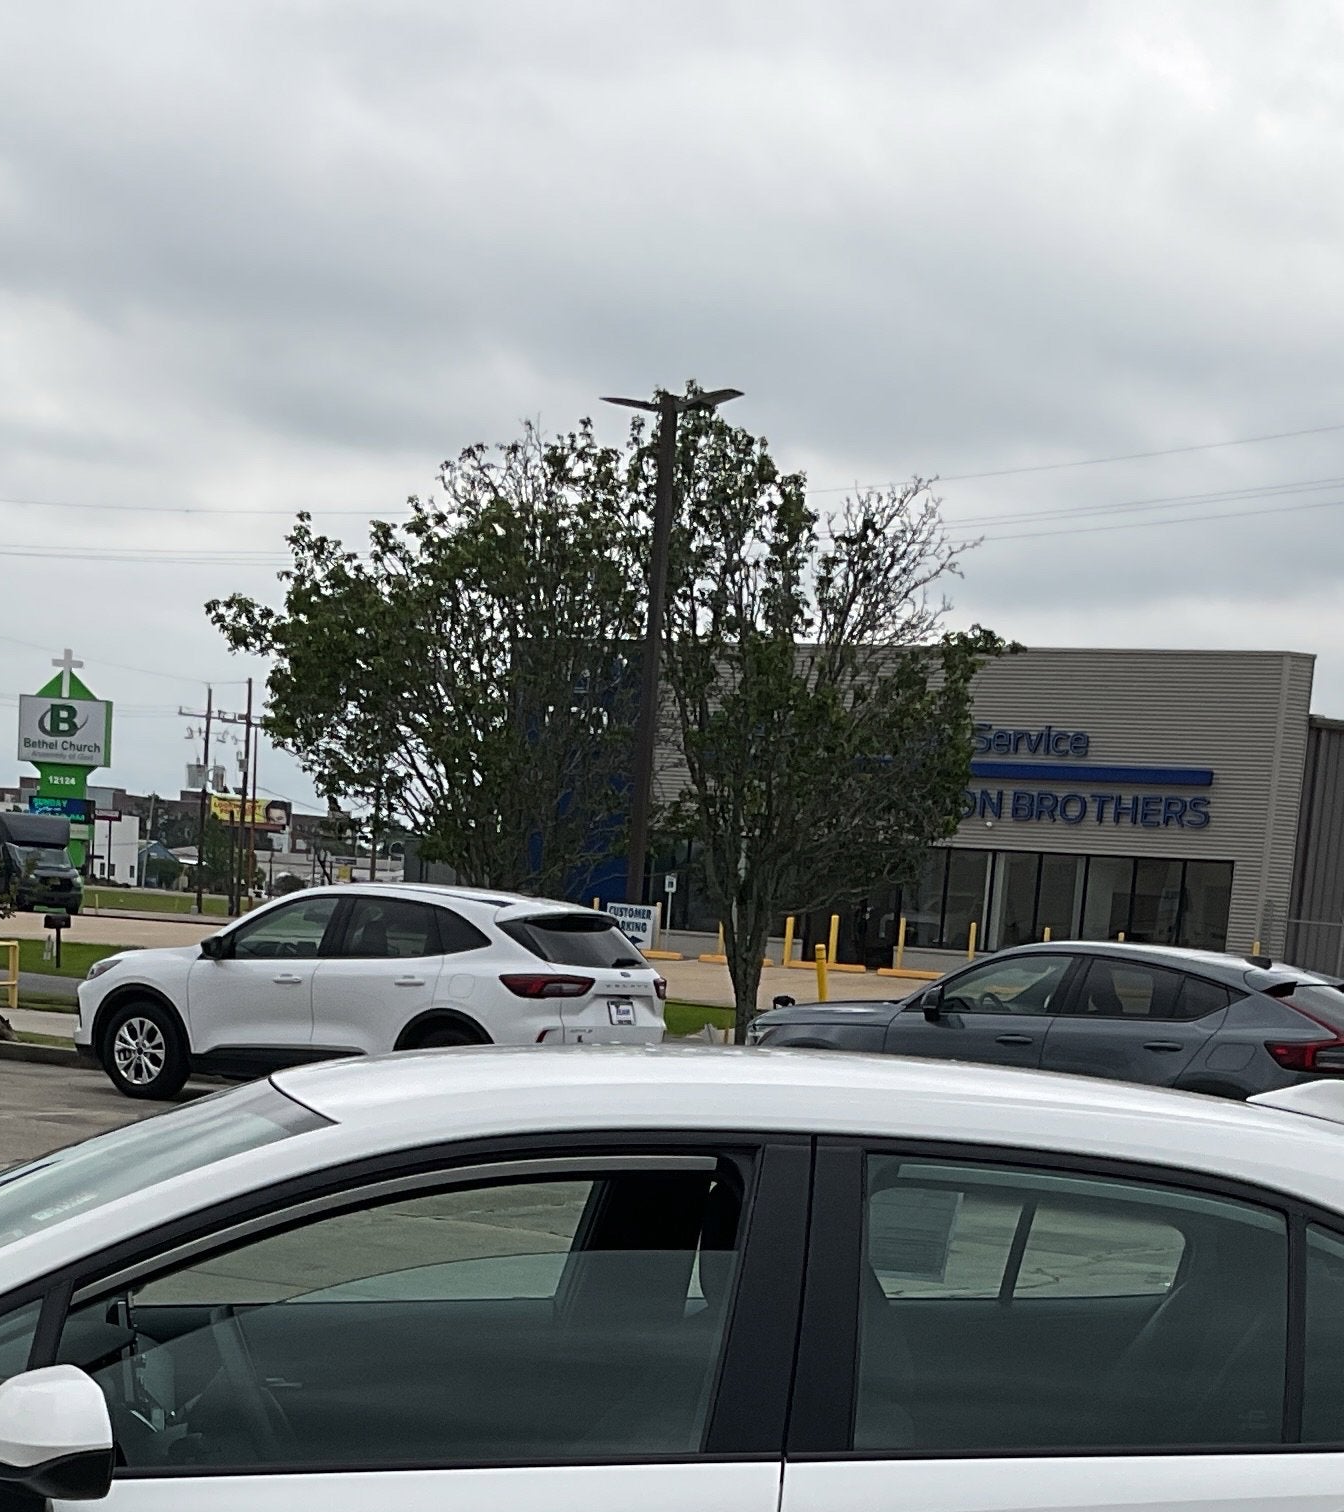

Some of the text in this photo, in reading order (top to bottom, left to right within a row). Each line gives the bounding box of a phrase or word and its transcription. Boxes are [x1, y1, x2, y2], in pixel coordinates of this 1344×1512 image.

[23, 737, 101, 753] Bethel Church
[974, 722, 1090, 758] Service
[48, 775, 76, 785] 12124
[1011, 790, 1211, 829] BROTHERS
[608, 906, 652, 920] CUSTOMER
